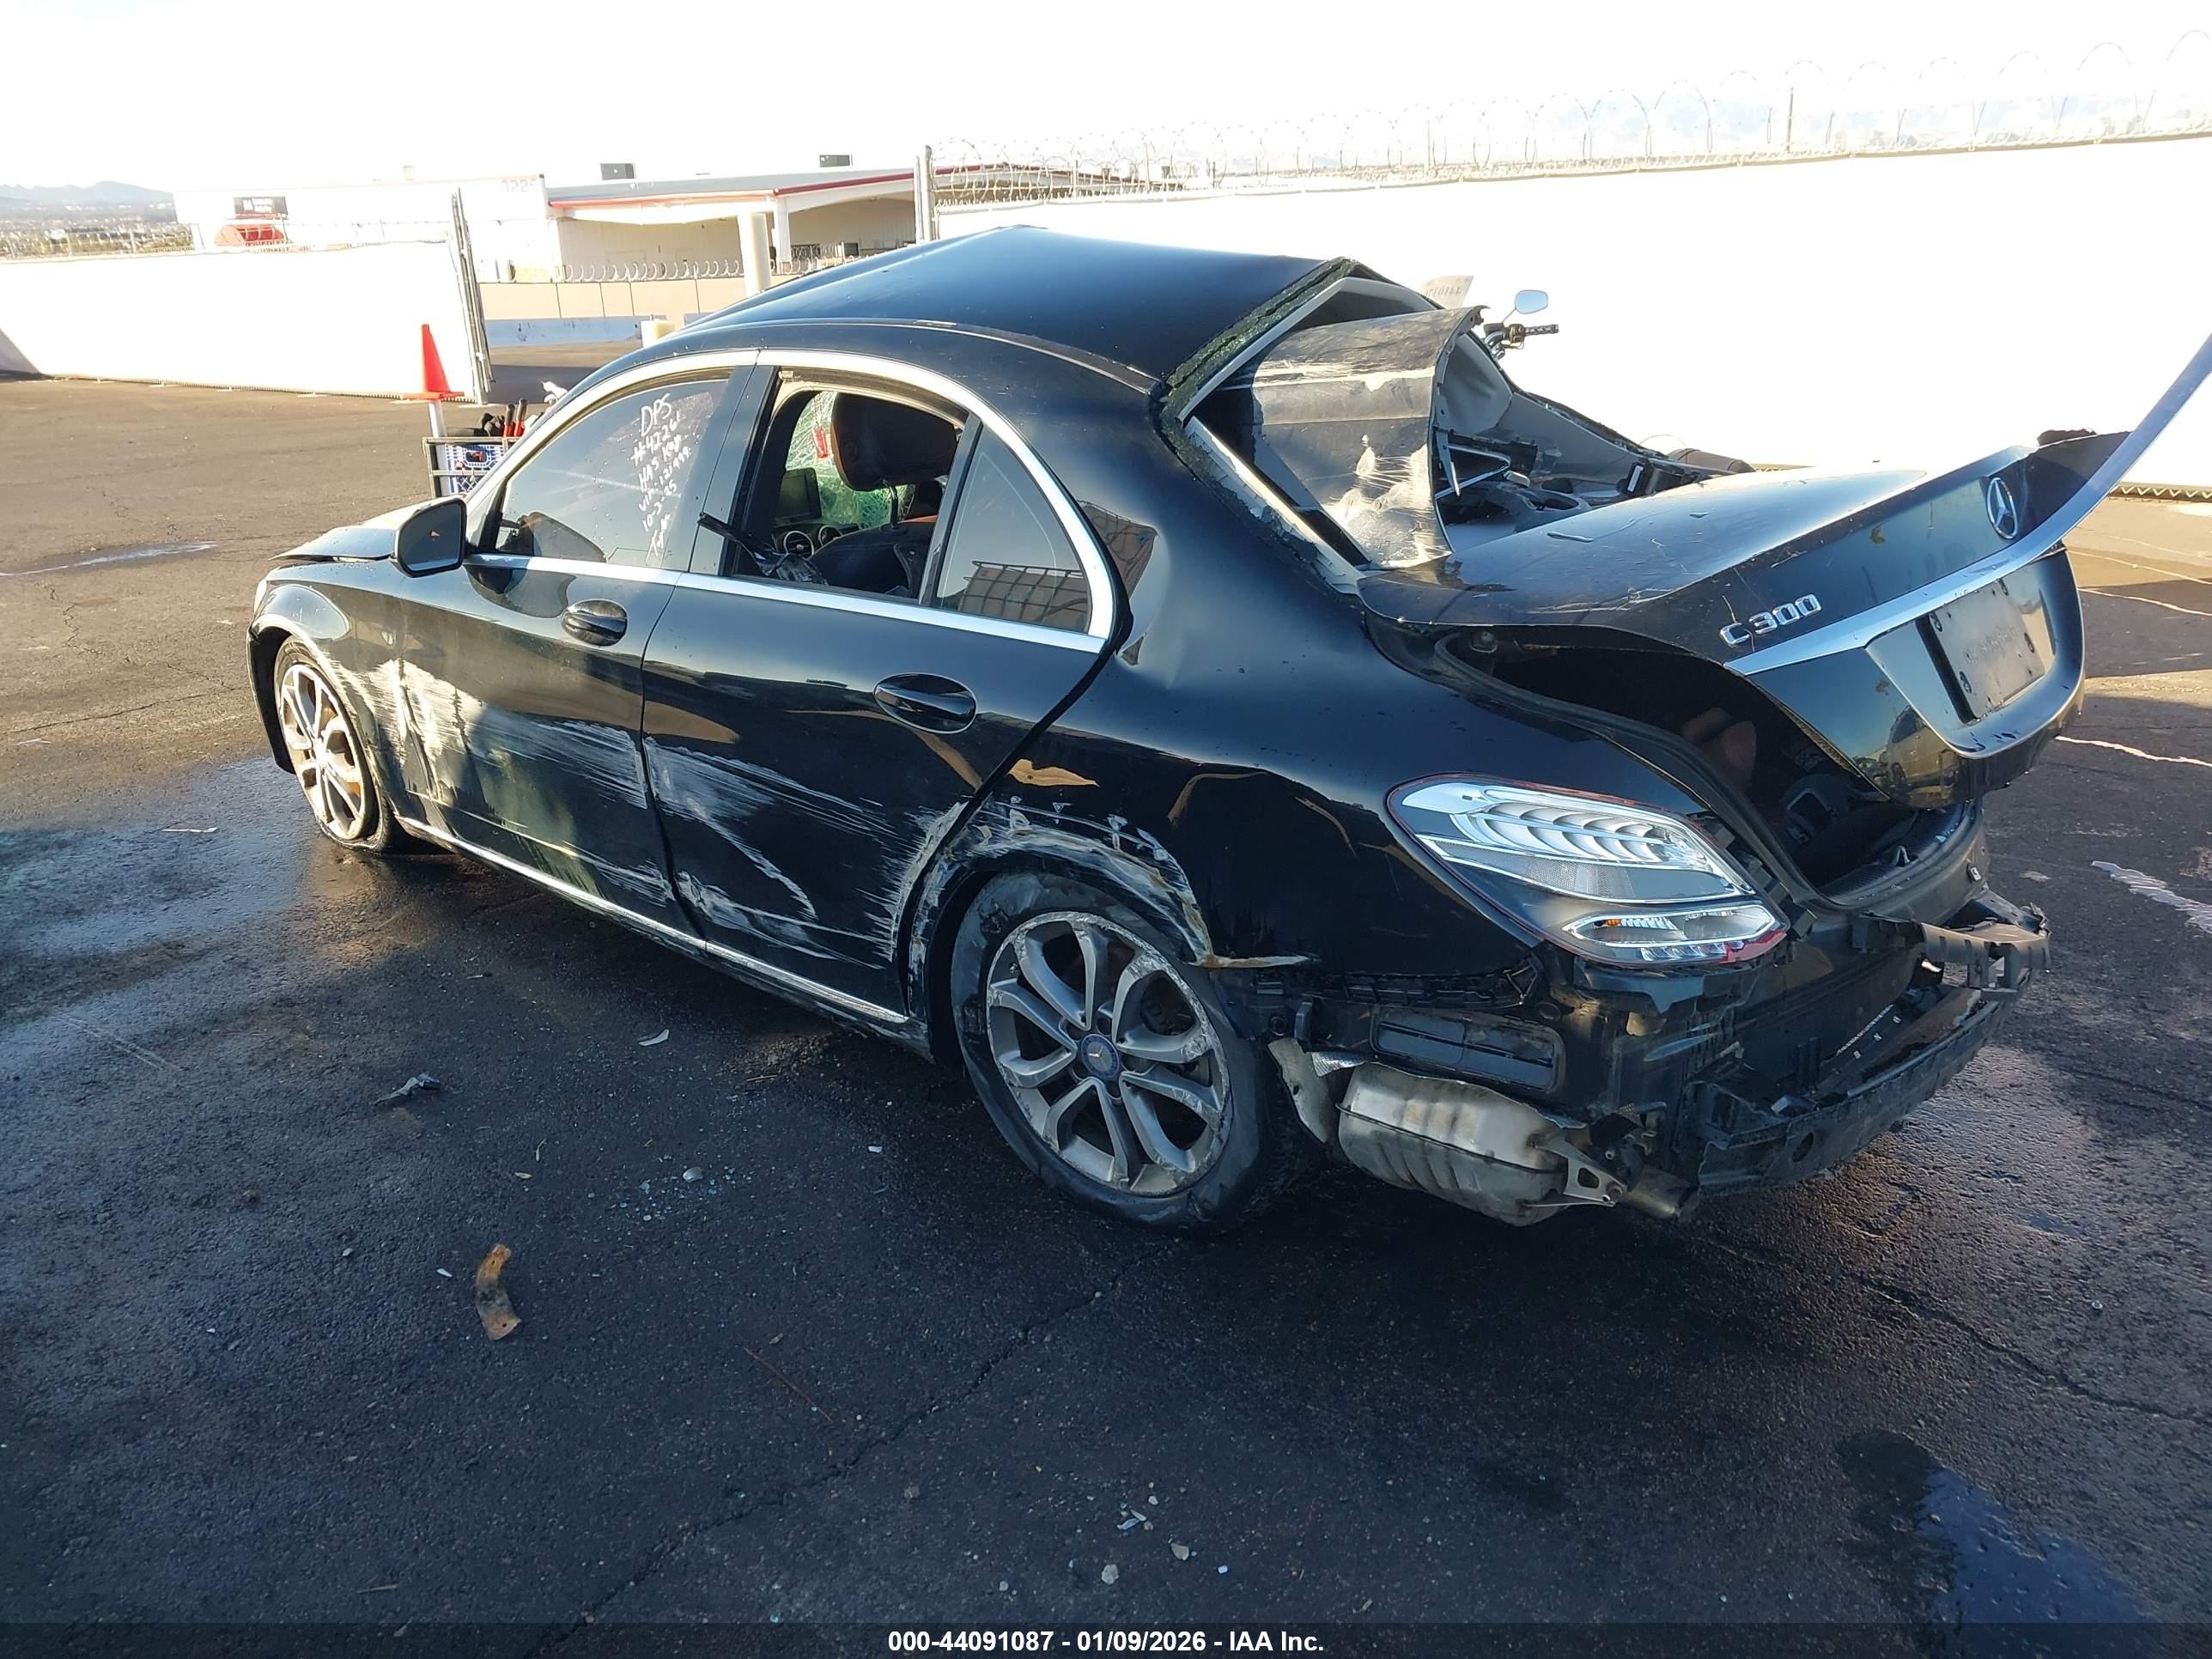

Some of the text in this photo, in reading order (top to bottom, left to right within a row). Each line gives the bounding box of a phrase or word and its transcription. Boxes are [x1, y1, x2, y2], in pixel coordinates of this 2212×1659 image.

[641, 392, 672, 437] DPS
[1720, 594, 1821, 646] C 300
